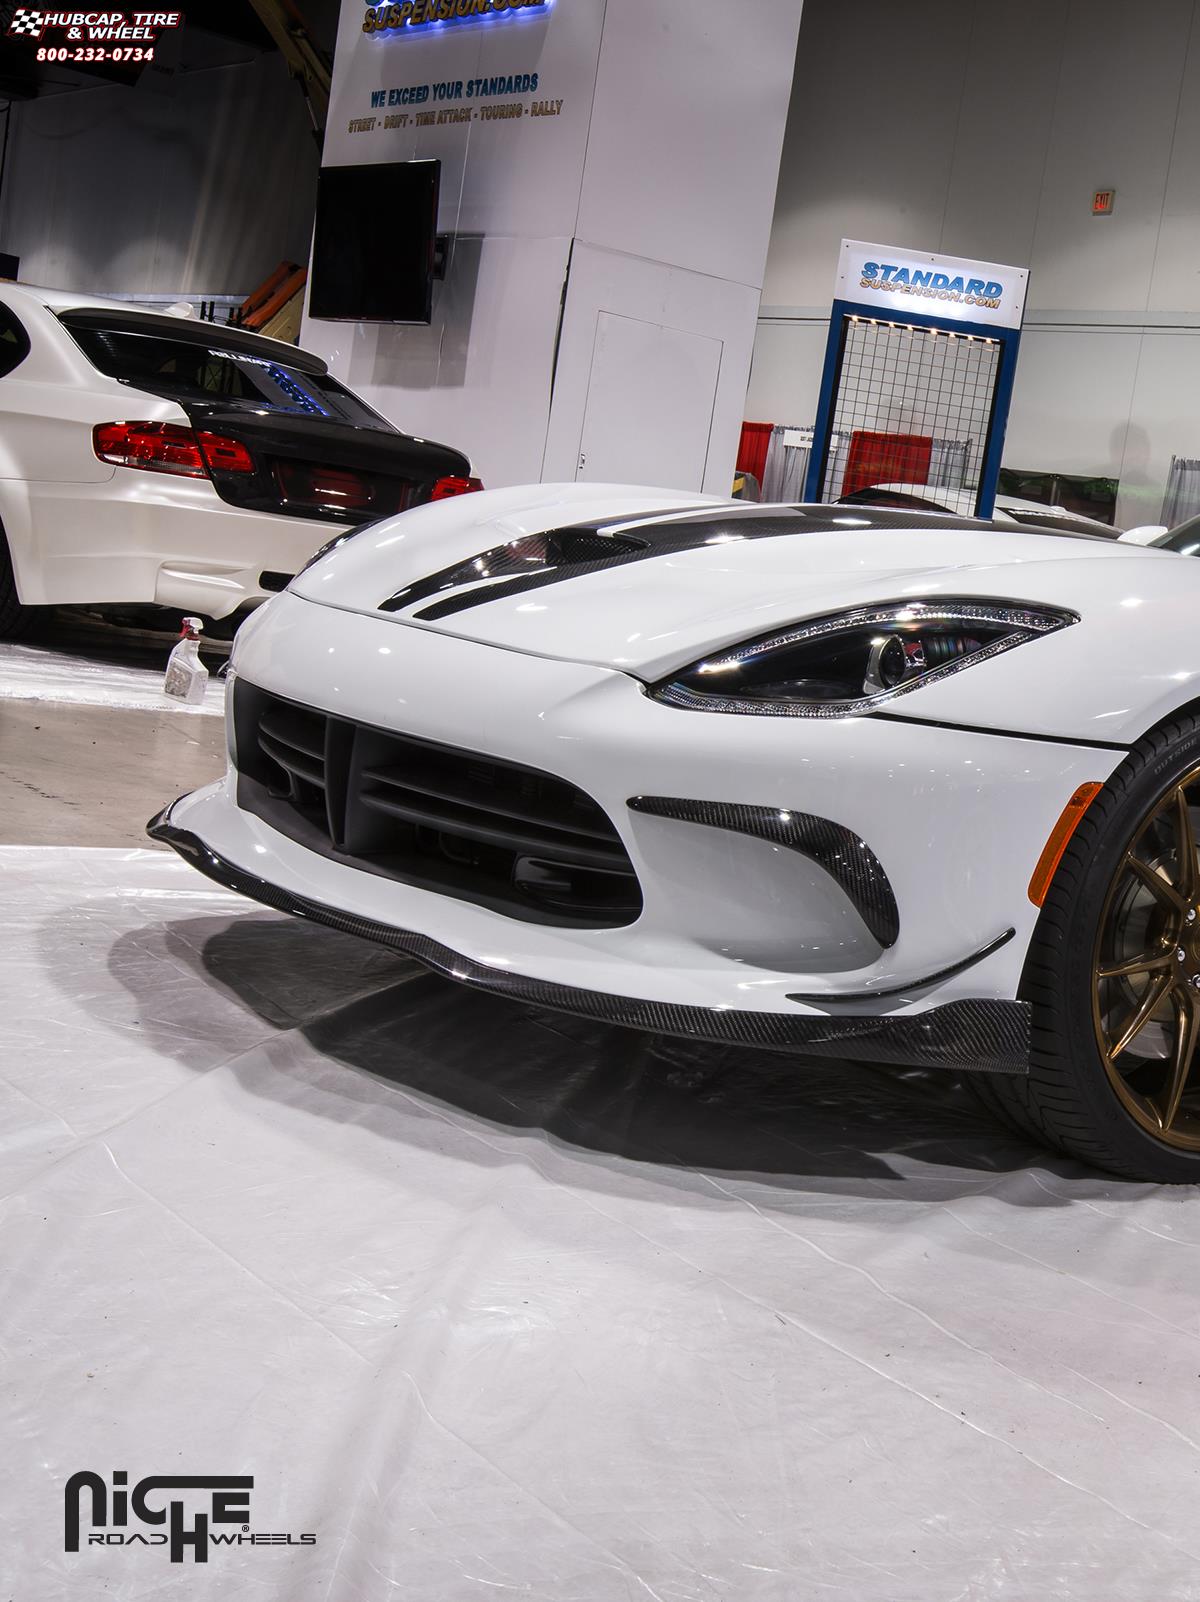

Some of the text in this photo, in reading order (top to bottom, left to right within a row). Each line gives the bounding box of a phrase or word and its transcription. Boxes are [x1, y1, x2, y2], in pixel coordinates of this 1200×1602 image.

[362, 0, 545, 33] SUSPENSION.
[370, 73, 539, 108] WE EXCEED YOUR STANDARDS
[348, 99, 564, 133] STREET DRIFT TIME ATTACK TOURING RALLY
[859, 277, 1001, 309] SUSPENSION.COM
[861, 262, 1004, 298] STANDARD
